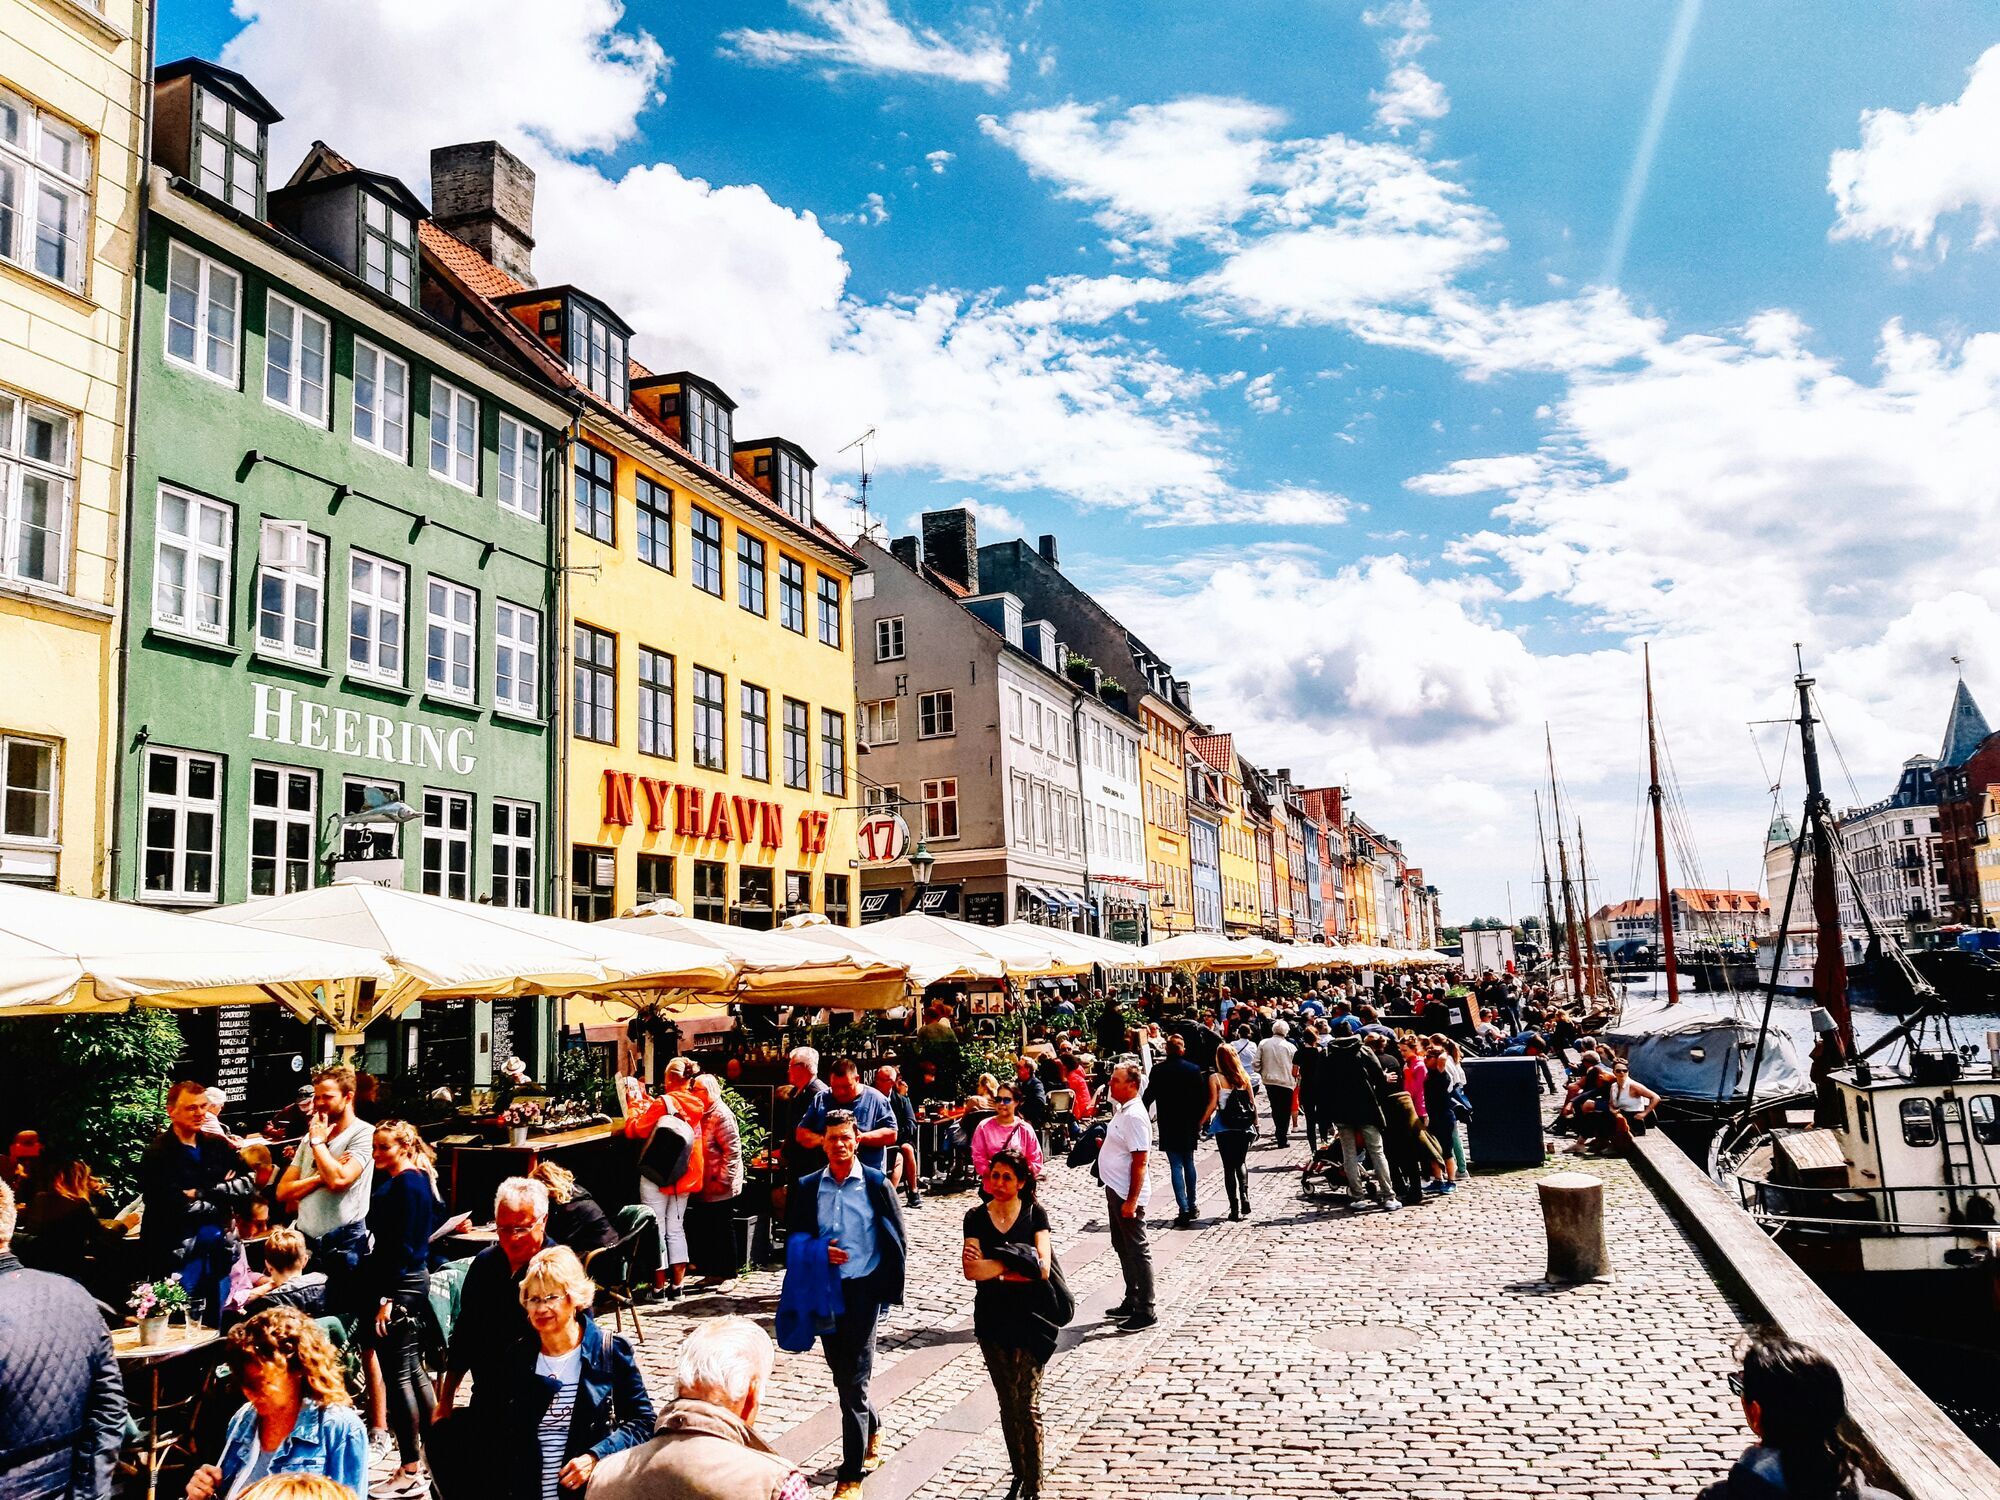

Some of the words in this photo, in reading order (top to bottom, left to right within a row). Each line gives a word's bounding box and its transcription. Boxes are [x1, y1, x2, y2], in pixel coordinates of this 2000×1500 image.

[248, 682, 477, 775] HEERING
[357, 829, 373, 844] 15
[604, 769, 784, 849] NYHAVN
[799, 809, 829, 854] 17
[859, 820, 895, 861] 17
